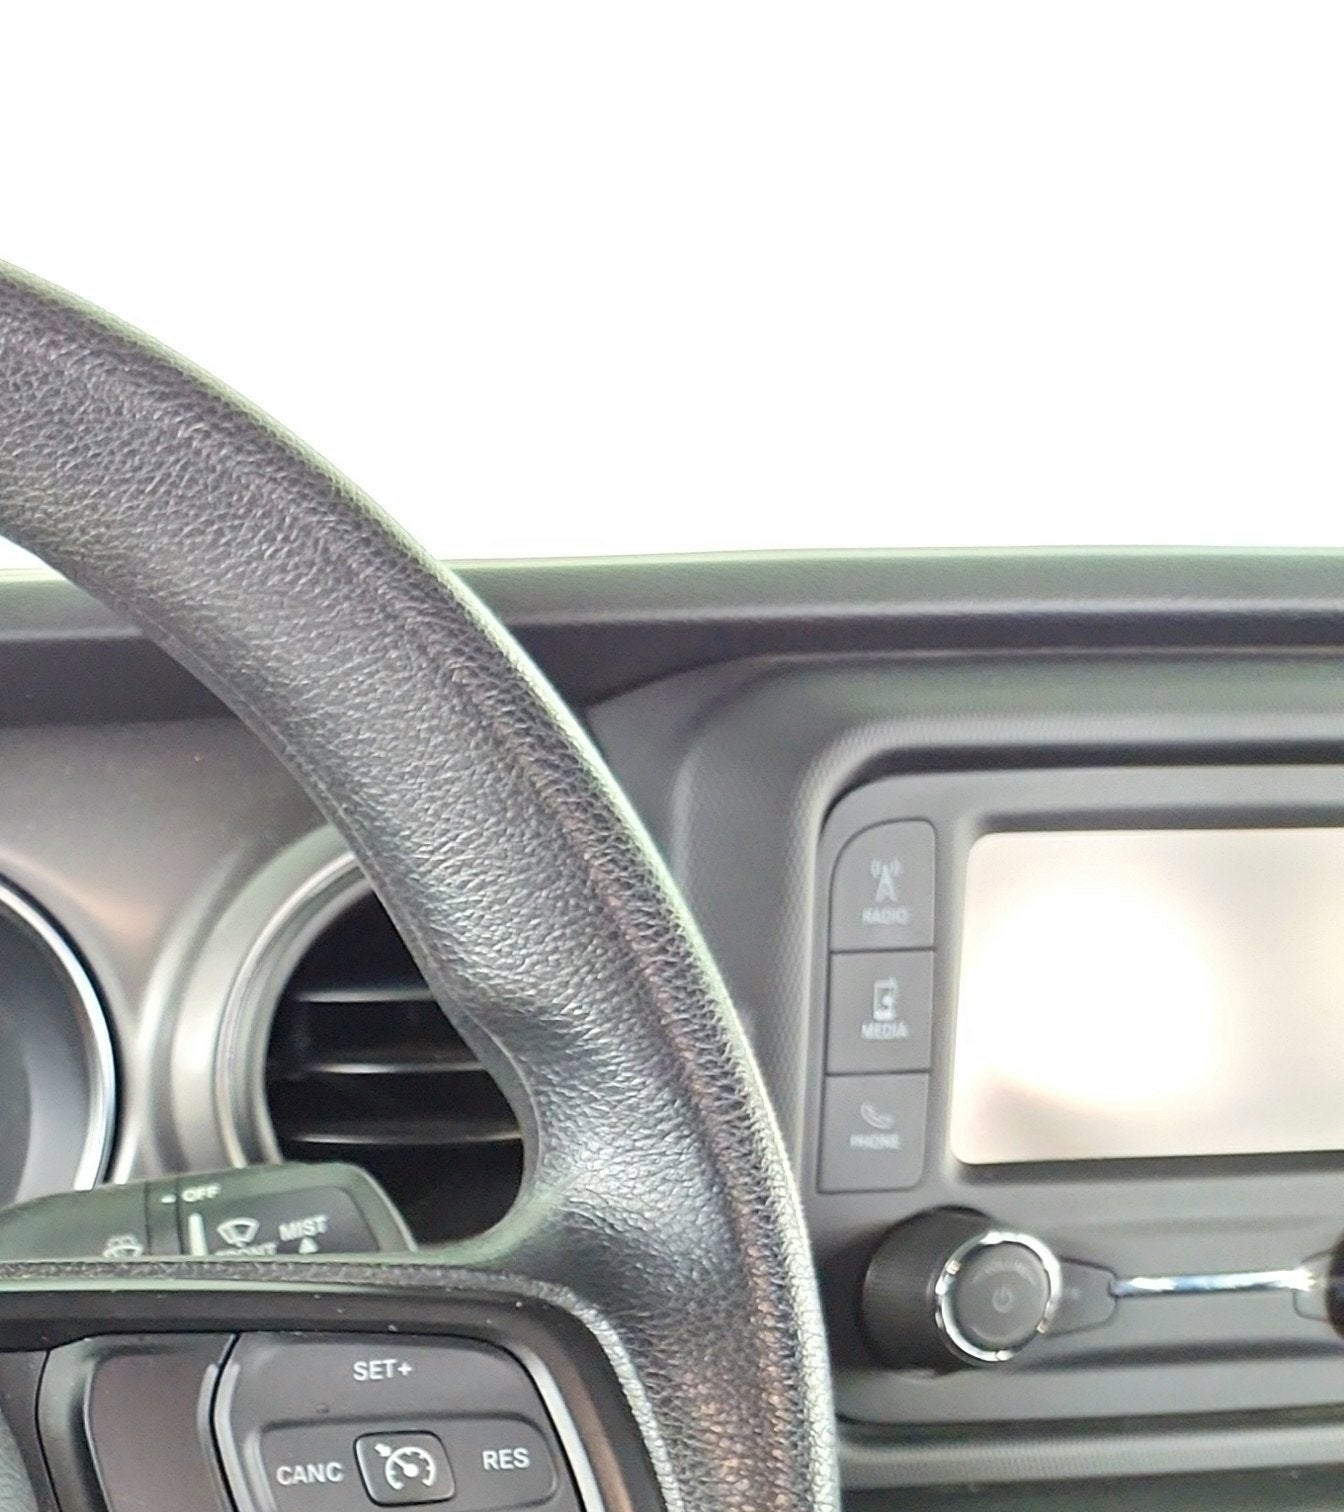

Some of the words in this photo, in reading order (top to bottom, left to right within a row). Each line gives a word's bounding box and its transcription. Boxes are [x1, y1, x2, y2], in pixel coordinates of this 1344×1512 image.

[862, 1022, 909, 1040] MEDIA
[850, 1133, 901, 1150] PHONE
[181, 1182, 221, 1203] OFF
[278, 1213, 330, 1242] MIST
[352, 1358, 413, 1382] SET+
[482, 1447, 531, 1471] RES
[275, 1461, 344, 1487] CANC
